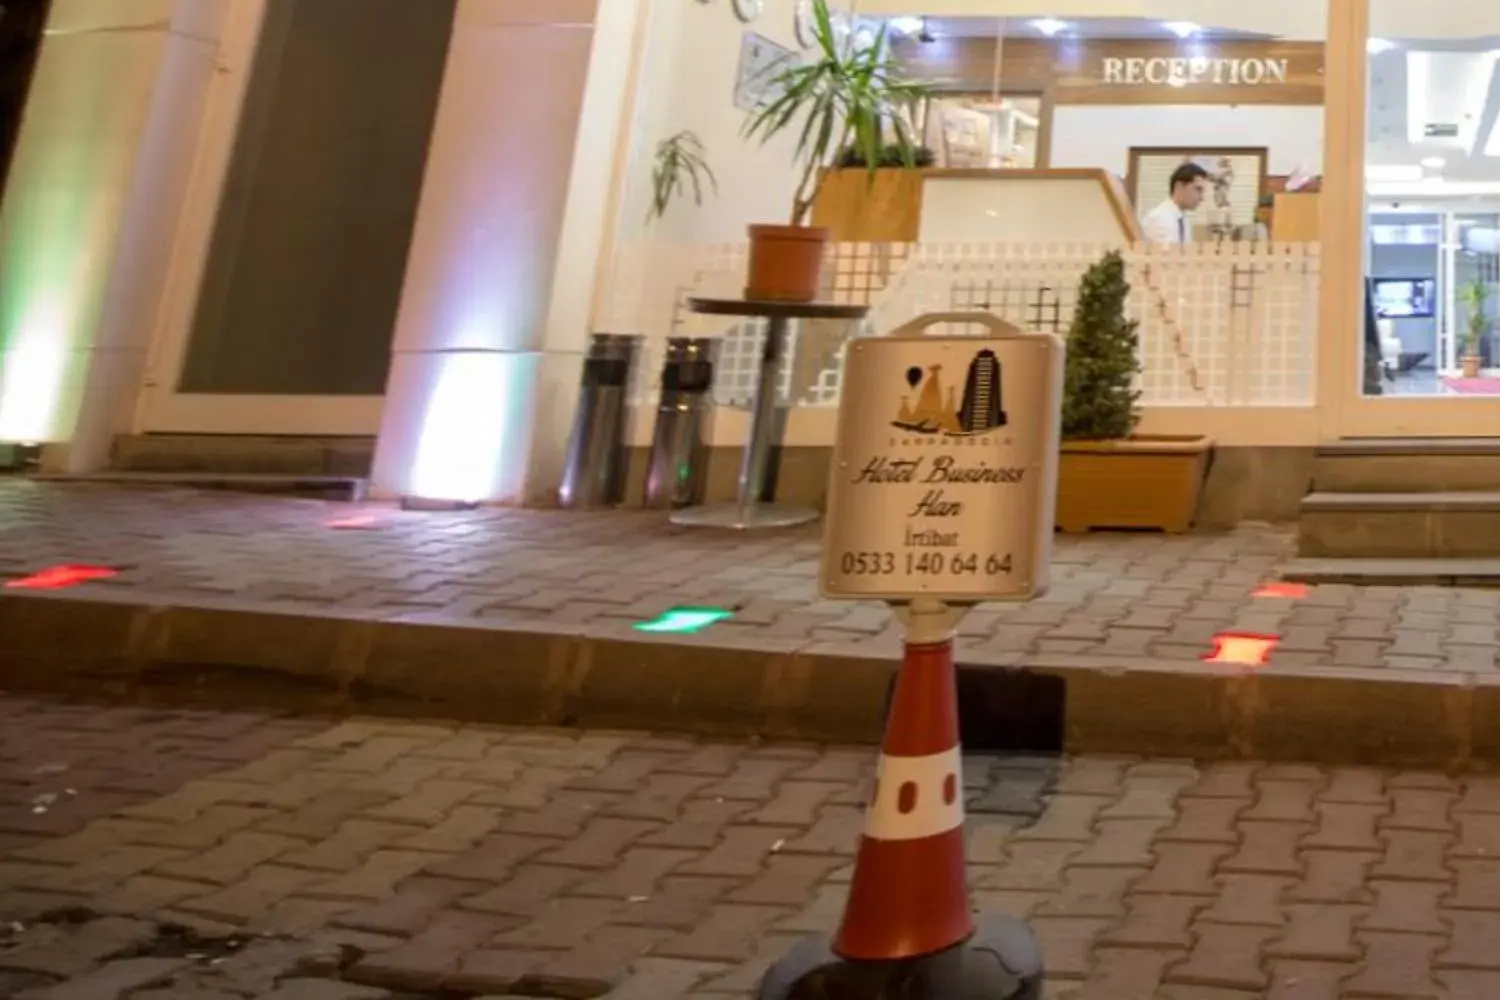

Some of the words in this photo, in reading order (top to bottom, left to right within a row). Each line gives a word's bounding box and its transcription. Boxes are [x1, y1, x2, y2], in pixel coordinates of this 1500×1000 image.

[1102, 56, 1288, 86] RECEPTION
[851, 455, 924, 484] Hotel
[918, 454, 1027, 483] Business
[906, 488, 963, 517] Han
[840, 551, 896, 576] 0533
[905, 551, 944, 576] 140
[950, 552, 979, 576] 64
[984, 552, 1013, 576] 64
